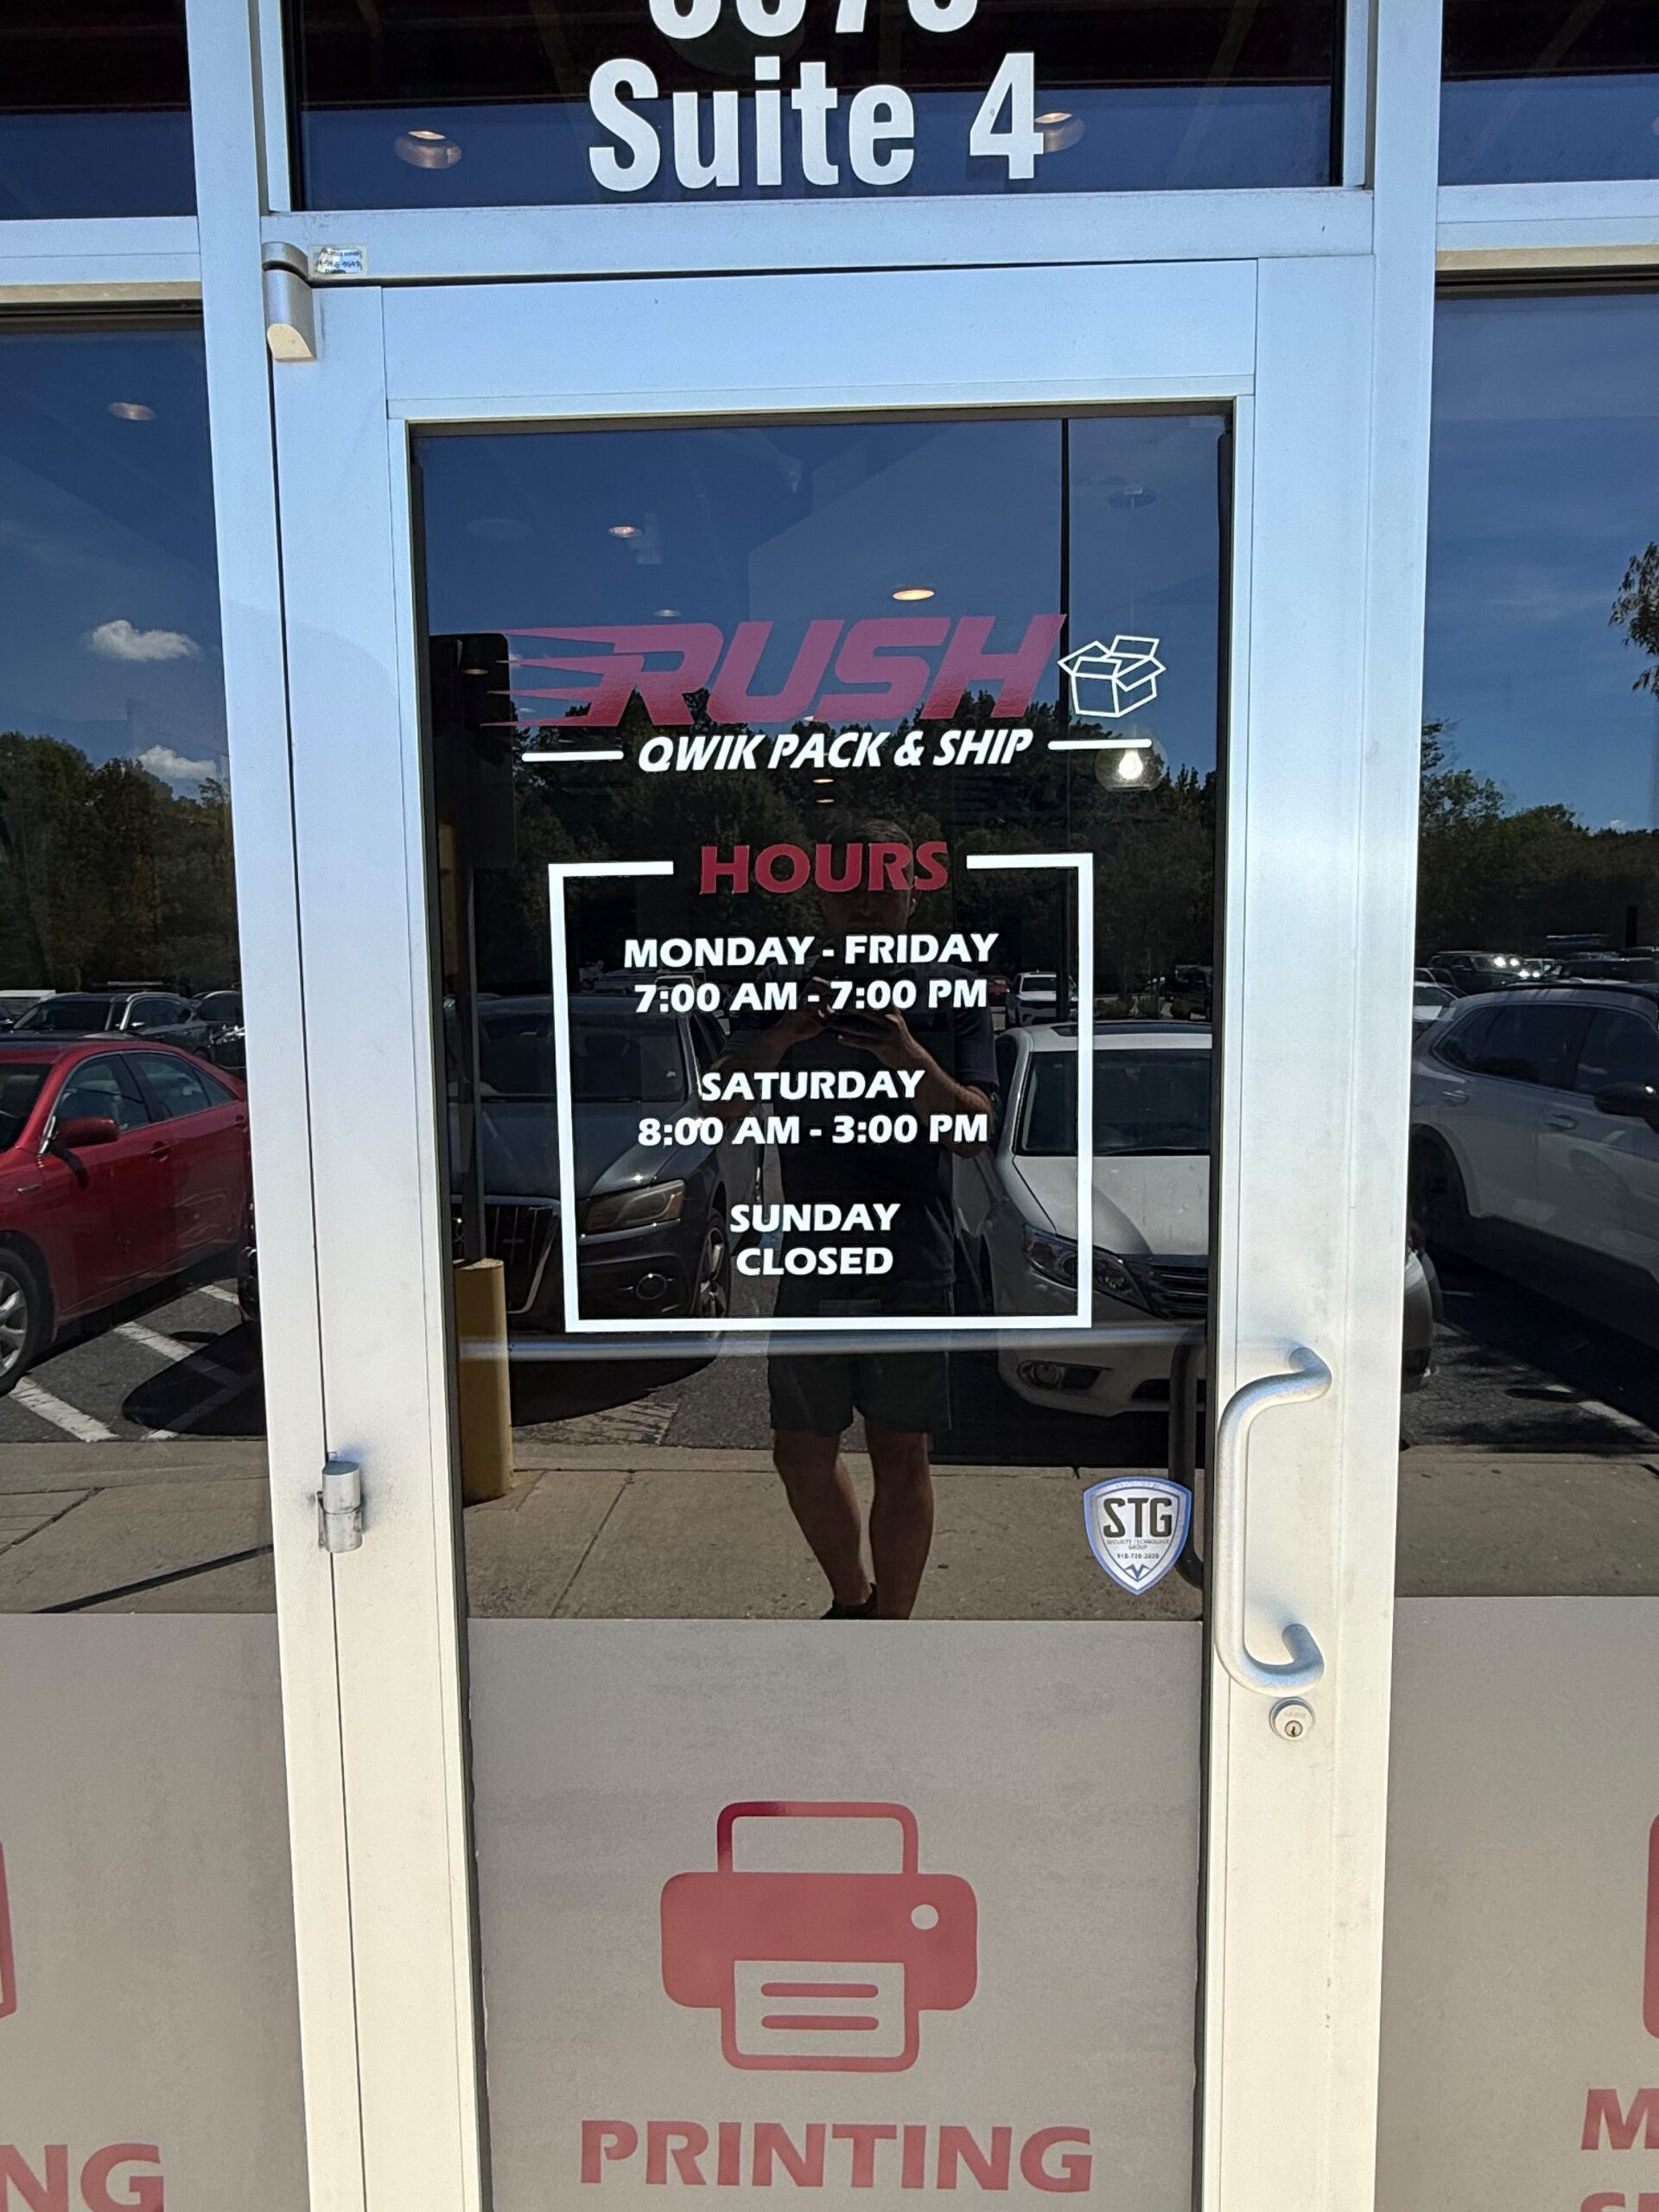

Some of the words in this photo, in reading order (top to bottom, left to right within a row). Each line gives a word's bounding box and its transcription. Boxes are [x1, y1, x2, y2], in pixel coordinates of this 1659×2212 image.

[588, 55, 914, 192] Suite
[969, 52, 1044, 180] 4
[497, 613, 1065, 727] RUSH
[638, 734, 765, 772] QWIK
[767, 732, 883, 769] PACK
[893, 730, 925, 767] &
[931, 728, 1034, 766] SHIP
[699, 841, 949, 894] HOURS
[624, 936, 815, 968] MONDAY
[844, 932, 999, 965] FRIDAY
[634, 982, 721, 1013] 7:00
[728, 982, 798, 1011] AM
[830, 980, 918, 1010] 7:00
[928, 979, 988, 1008] PM
[701, 1070, 925, 1102] SATURDAY
[638, 1116, 724, 1147] 8:00
[731, 1116, 800, 1145] AM
[831, 1115, 918, 1144] 3:00
[929, 1114, 988, 1142] PM
[729, 1203, 901, 1234] SUNDAY
[736, 1247, 893, 1276] CLOSED
[1103, 1497, 1173, 1538] STG
[581, 2120, 1093, 2193] PRINTING
